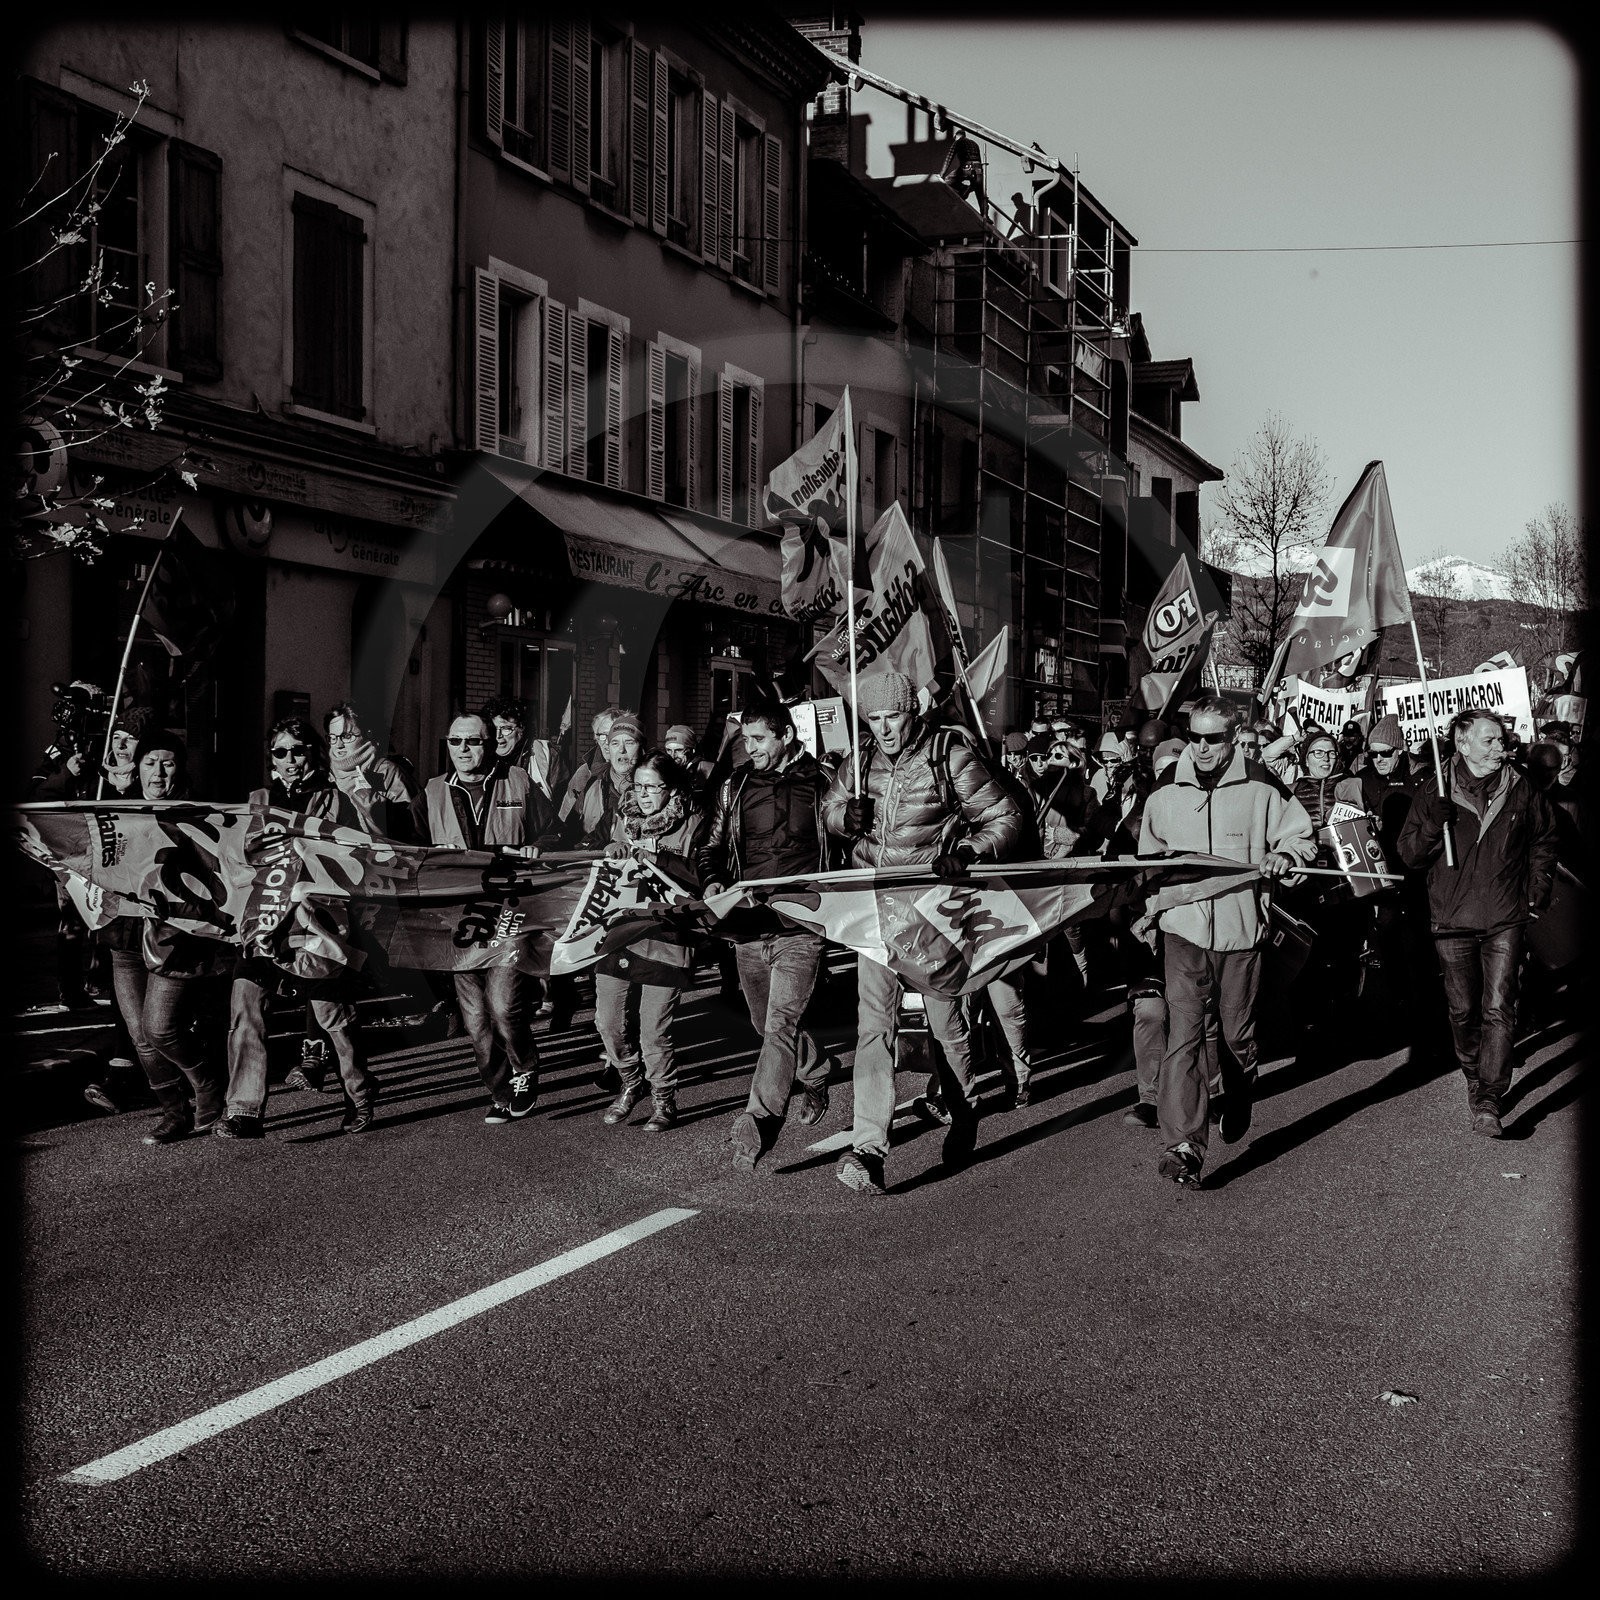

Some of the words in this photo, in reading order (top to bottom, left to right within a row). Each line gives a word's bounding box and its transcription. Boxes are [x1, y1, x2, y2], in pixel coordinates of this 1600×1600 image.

[351, 543, 399, 566] Générale
[569, 547, 635, 579] RESTAURANT
[734, 592, 759, 609] en
[1300, 694, 1344, 726] RETRAIT
[1333, 806, 1343, 816] JE
